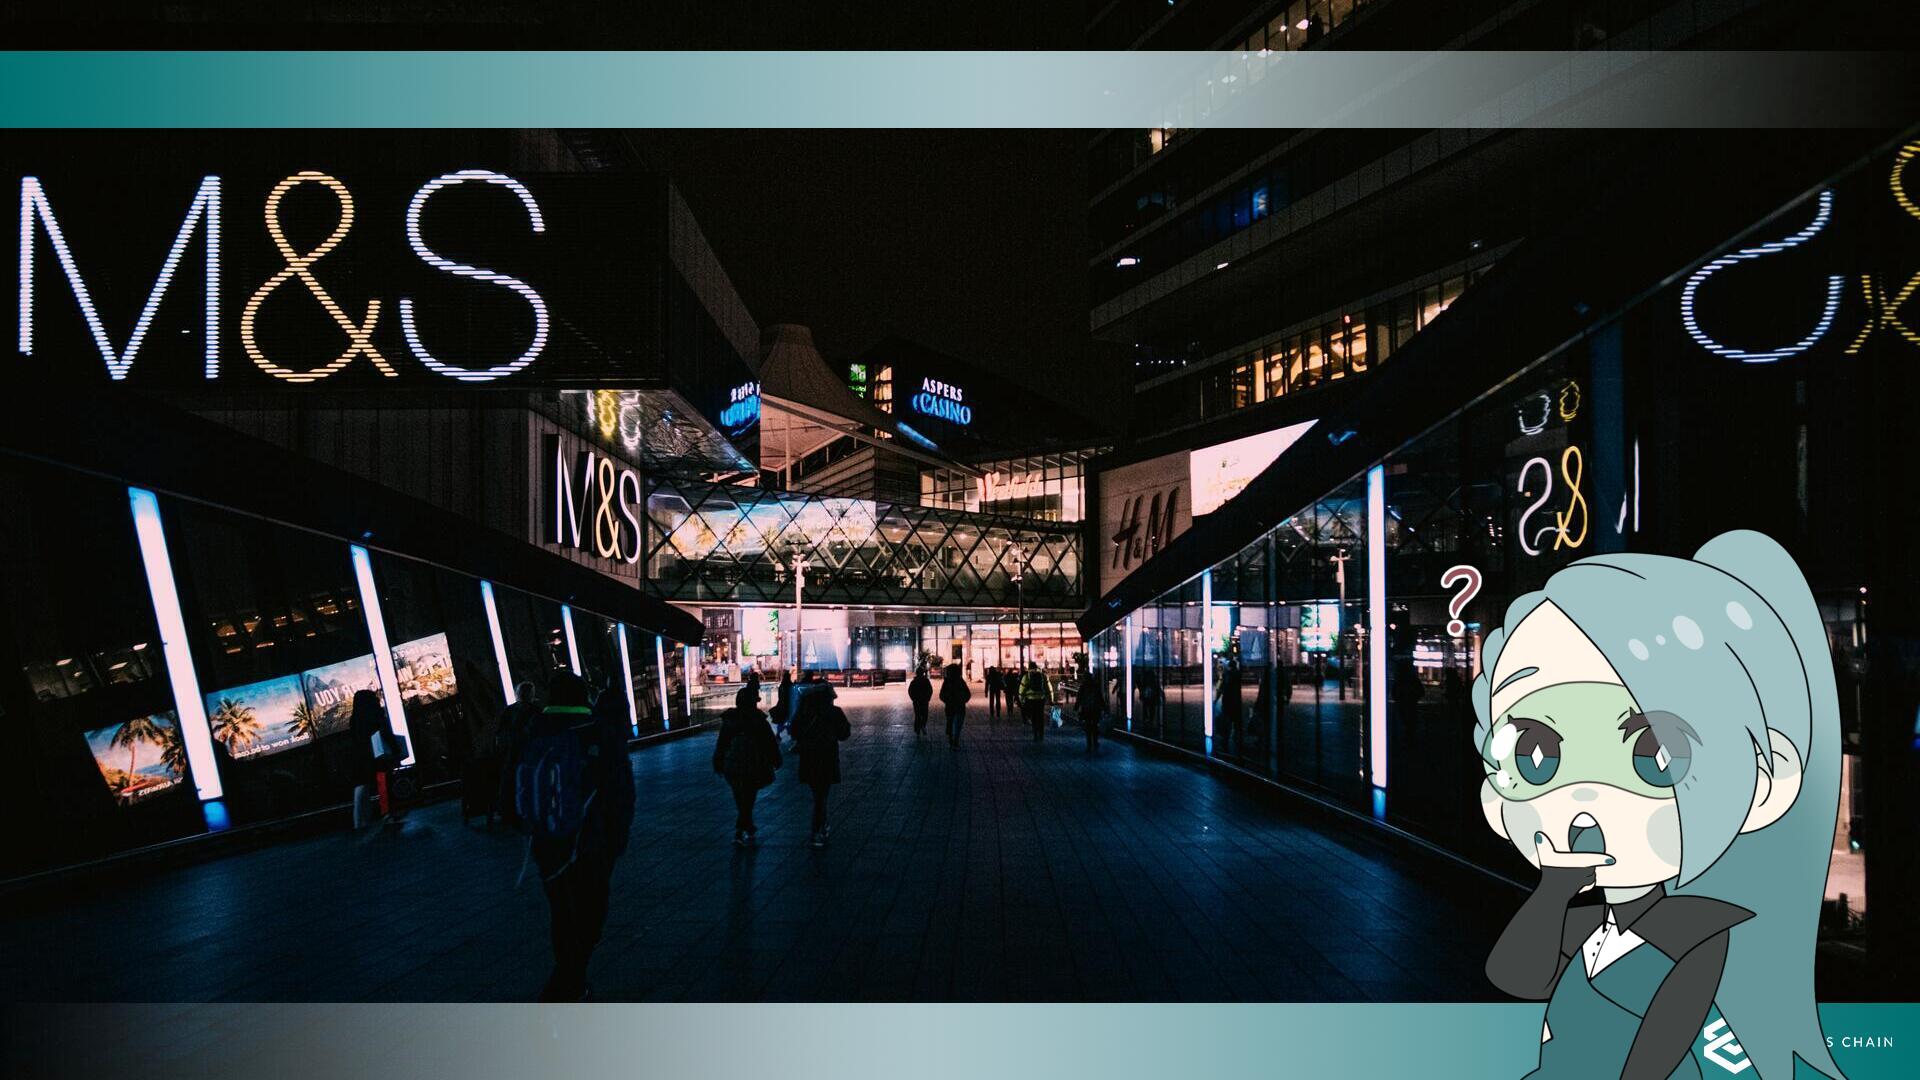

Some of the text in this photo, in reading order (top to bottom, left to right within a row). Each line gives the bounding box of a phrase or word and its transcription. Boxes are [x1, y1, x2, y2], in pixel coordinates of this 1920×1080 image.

[18, 168, 551, 383] M&S
[919, 393, 972, 425] CASINO
[922, 376, 963, 402] ASPERS
[556, 435, 641, 564] M&S
[1111, 486, 1179, 571] H&M
